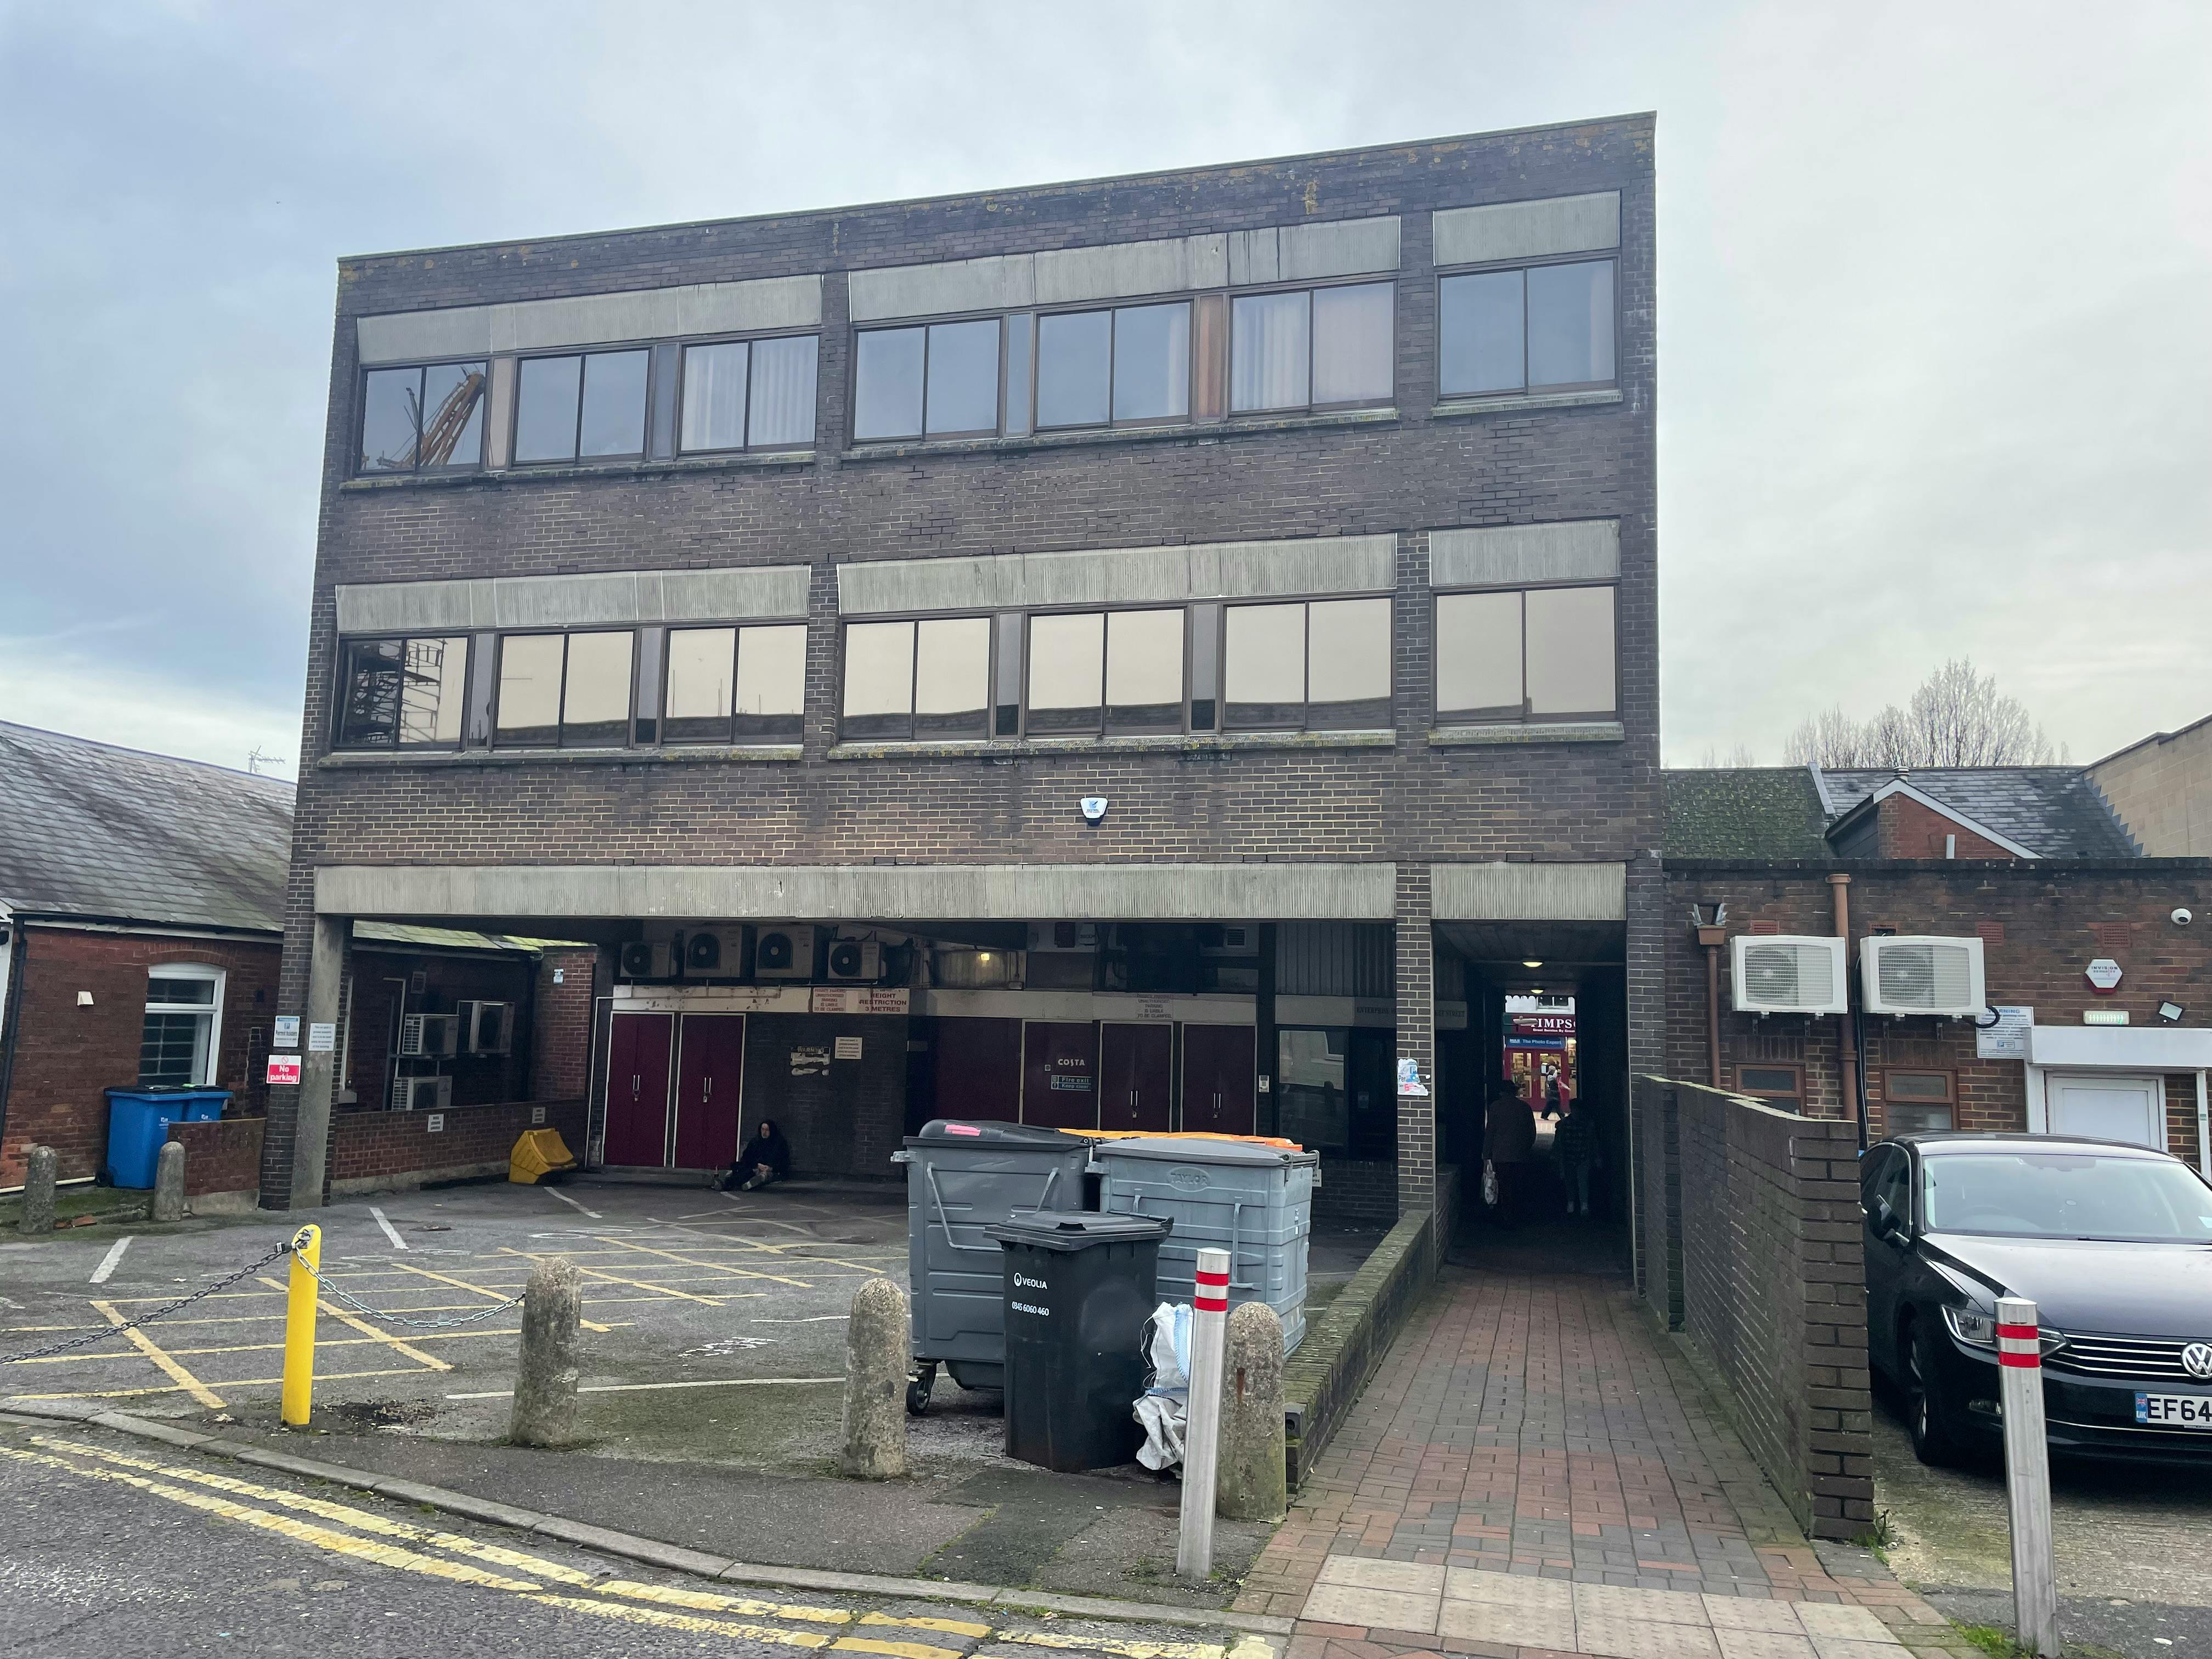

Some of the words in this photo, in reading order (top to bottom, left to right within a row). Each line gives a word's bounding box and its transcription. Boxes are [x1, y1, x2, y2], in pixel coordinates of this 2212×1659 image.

[1531, 1018, 1576, 1029] IMPS
[1058, 1058, 1086, 1066] COSTA
[269, 1073, 297, 1082] parking
[1170, 1173, 1207, 1186] TAYLOR
[1022, 1277, 1048, 1290] VEOLIA
[1023, 1304, 1037, 1314] 6060
[1037, 1307, 1049, 1316] 460
[2136, 1410, 2147, 1419] UK
[2147, 1397, 2212, 1422] EF64
